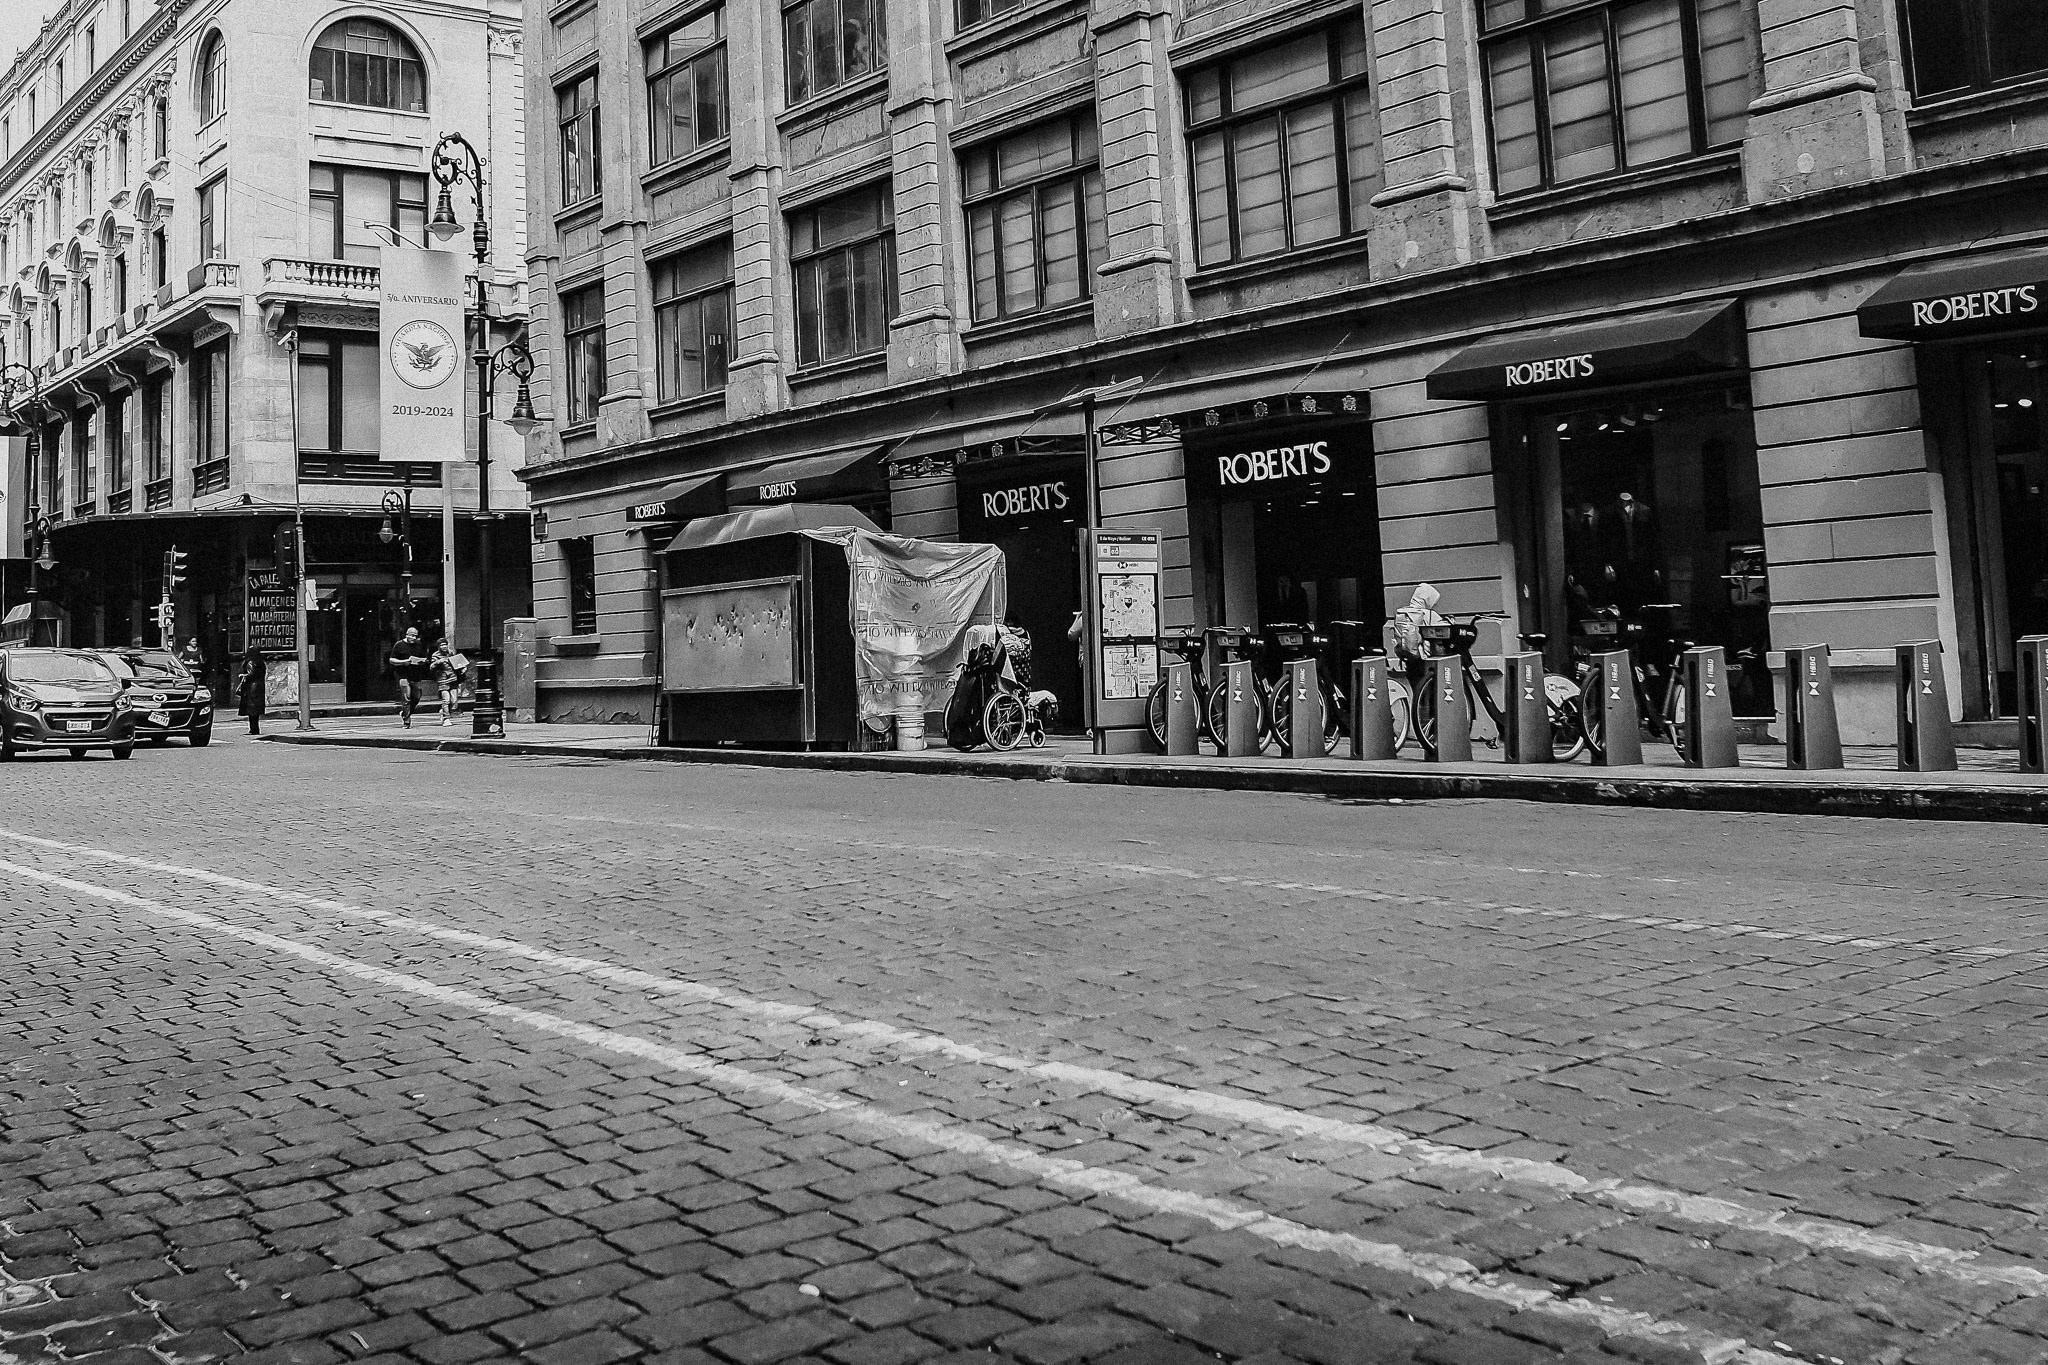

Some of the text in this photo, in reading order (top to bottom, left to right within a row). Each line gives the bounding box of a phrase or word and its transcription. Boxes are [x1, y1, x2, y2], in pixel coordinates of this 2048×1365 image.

[401, 295, 459, 306] ANIVERSARIO
[1912, 285, 2038, 326] ROBERT'S
[1505, 354, 1595, 387] ROBERT'S
[391, 405, 454, 417] 2019-2024
[1218, 441, 1331, 485] ROBERT'S
[982, 481, 1068, 518] ROBERT'S
[248, 573, 280, 590] LA PALE
[249, 596, 295, 607] ALMACENES
[249, 624, 295, 636] ARTEFACTOS
[251, 637, 294, 648] NACIONALES
